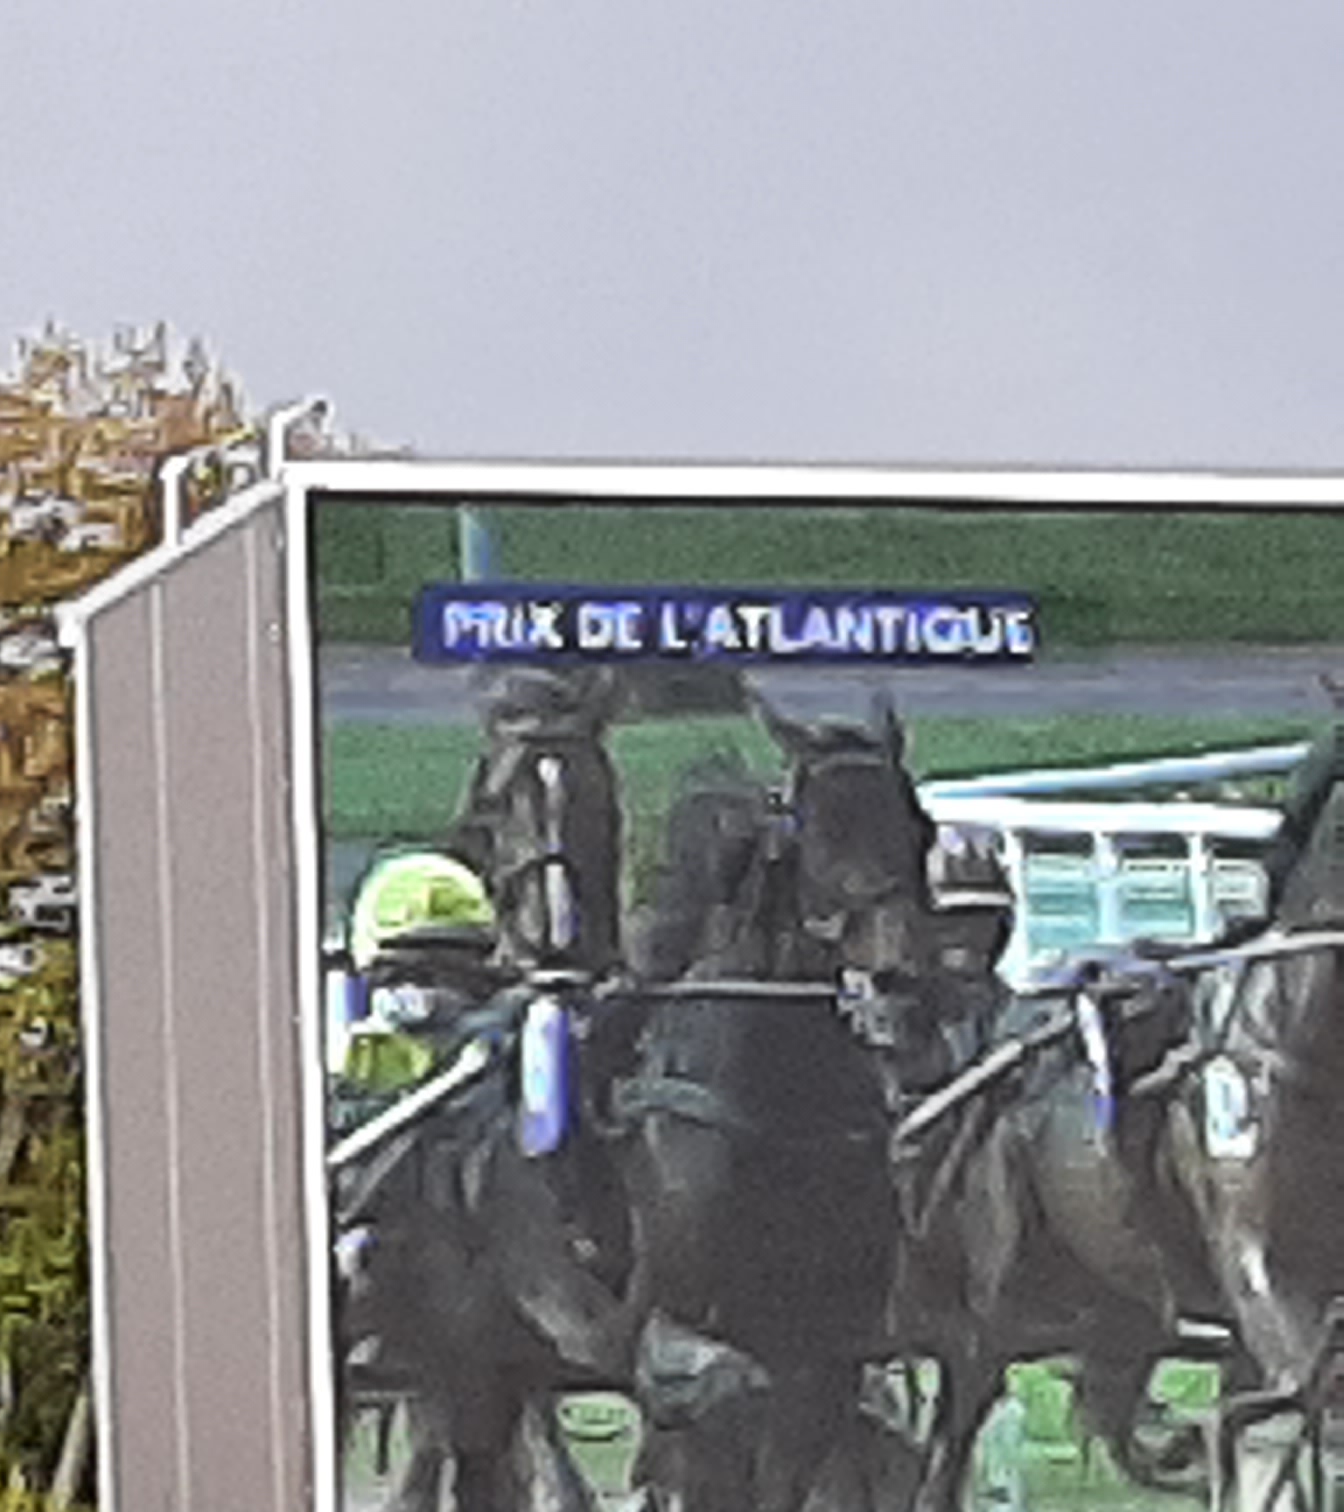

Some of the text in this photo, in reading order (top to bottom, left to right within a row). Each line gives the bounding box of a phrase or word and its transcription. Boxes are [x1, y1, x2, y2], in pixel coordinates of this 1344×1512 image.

[442, 600, 1034, 654] PRIX DE L'ATLANTIQUE
